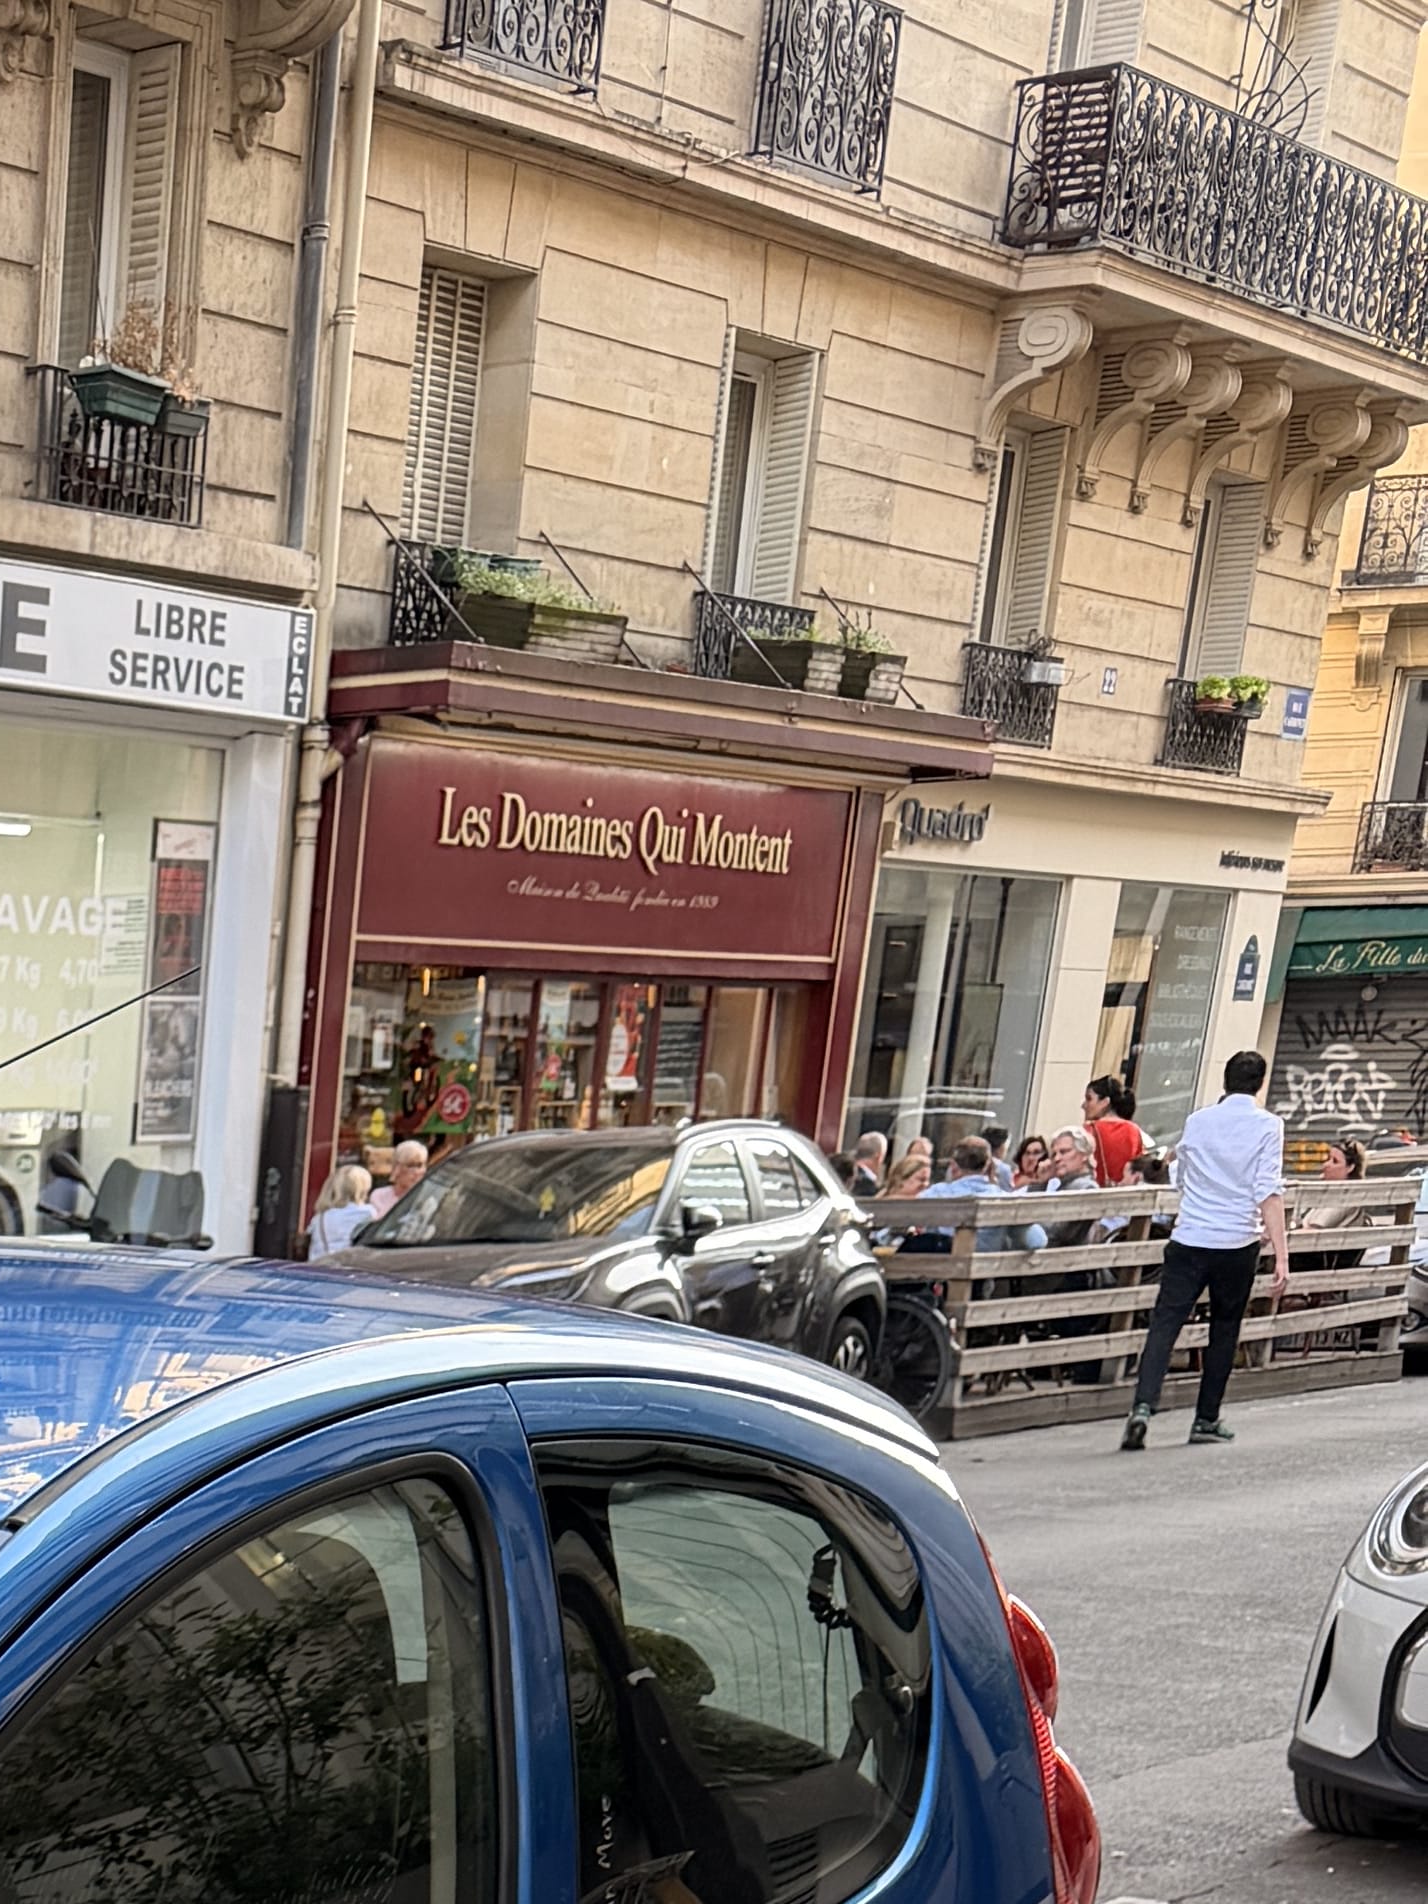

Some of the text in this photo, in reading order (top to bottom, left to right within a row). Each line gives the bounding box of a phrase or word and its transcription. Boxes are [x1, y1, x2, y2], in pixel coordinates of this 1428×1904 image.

[135, 599, 227, 647] LIBRE
[108, 648, 245, 700] SERVICE
[288, 616, 308, 715] ECLAT
[438, 786, 793, 876] Les Domaines Qui Montent
[15, 955, 42, 991] Kg
[1316, 944, 1350, 973] La
[1351, 940, 1401, 969] Fille
